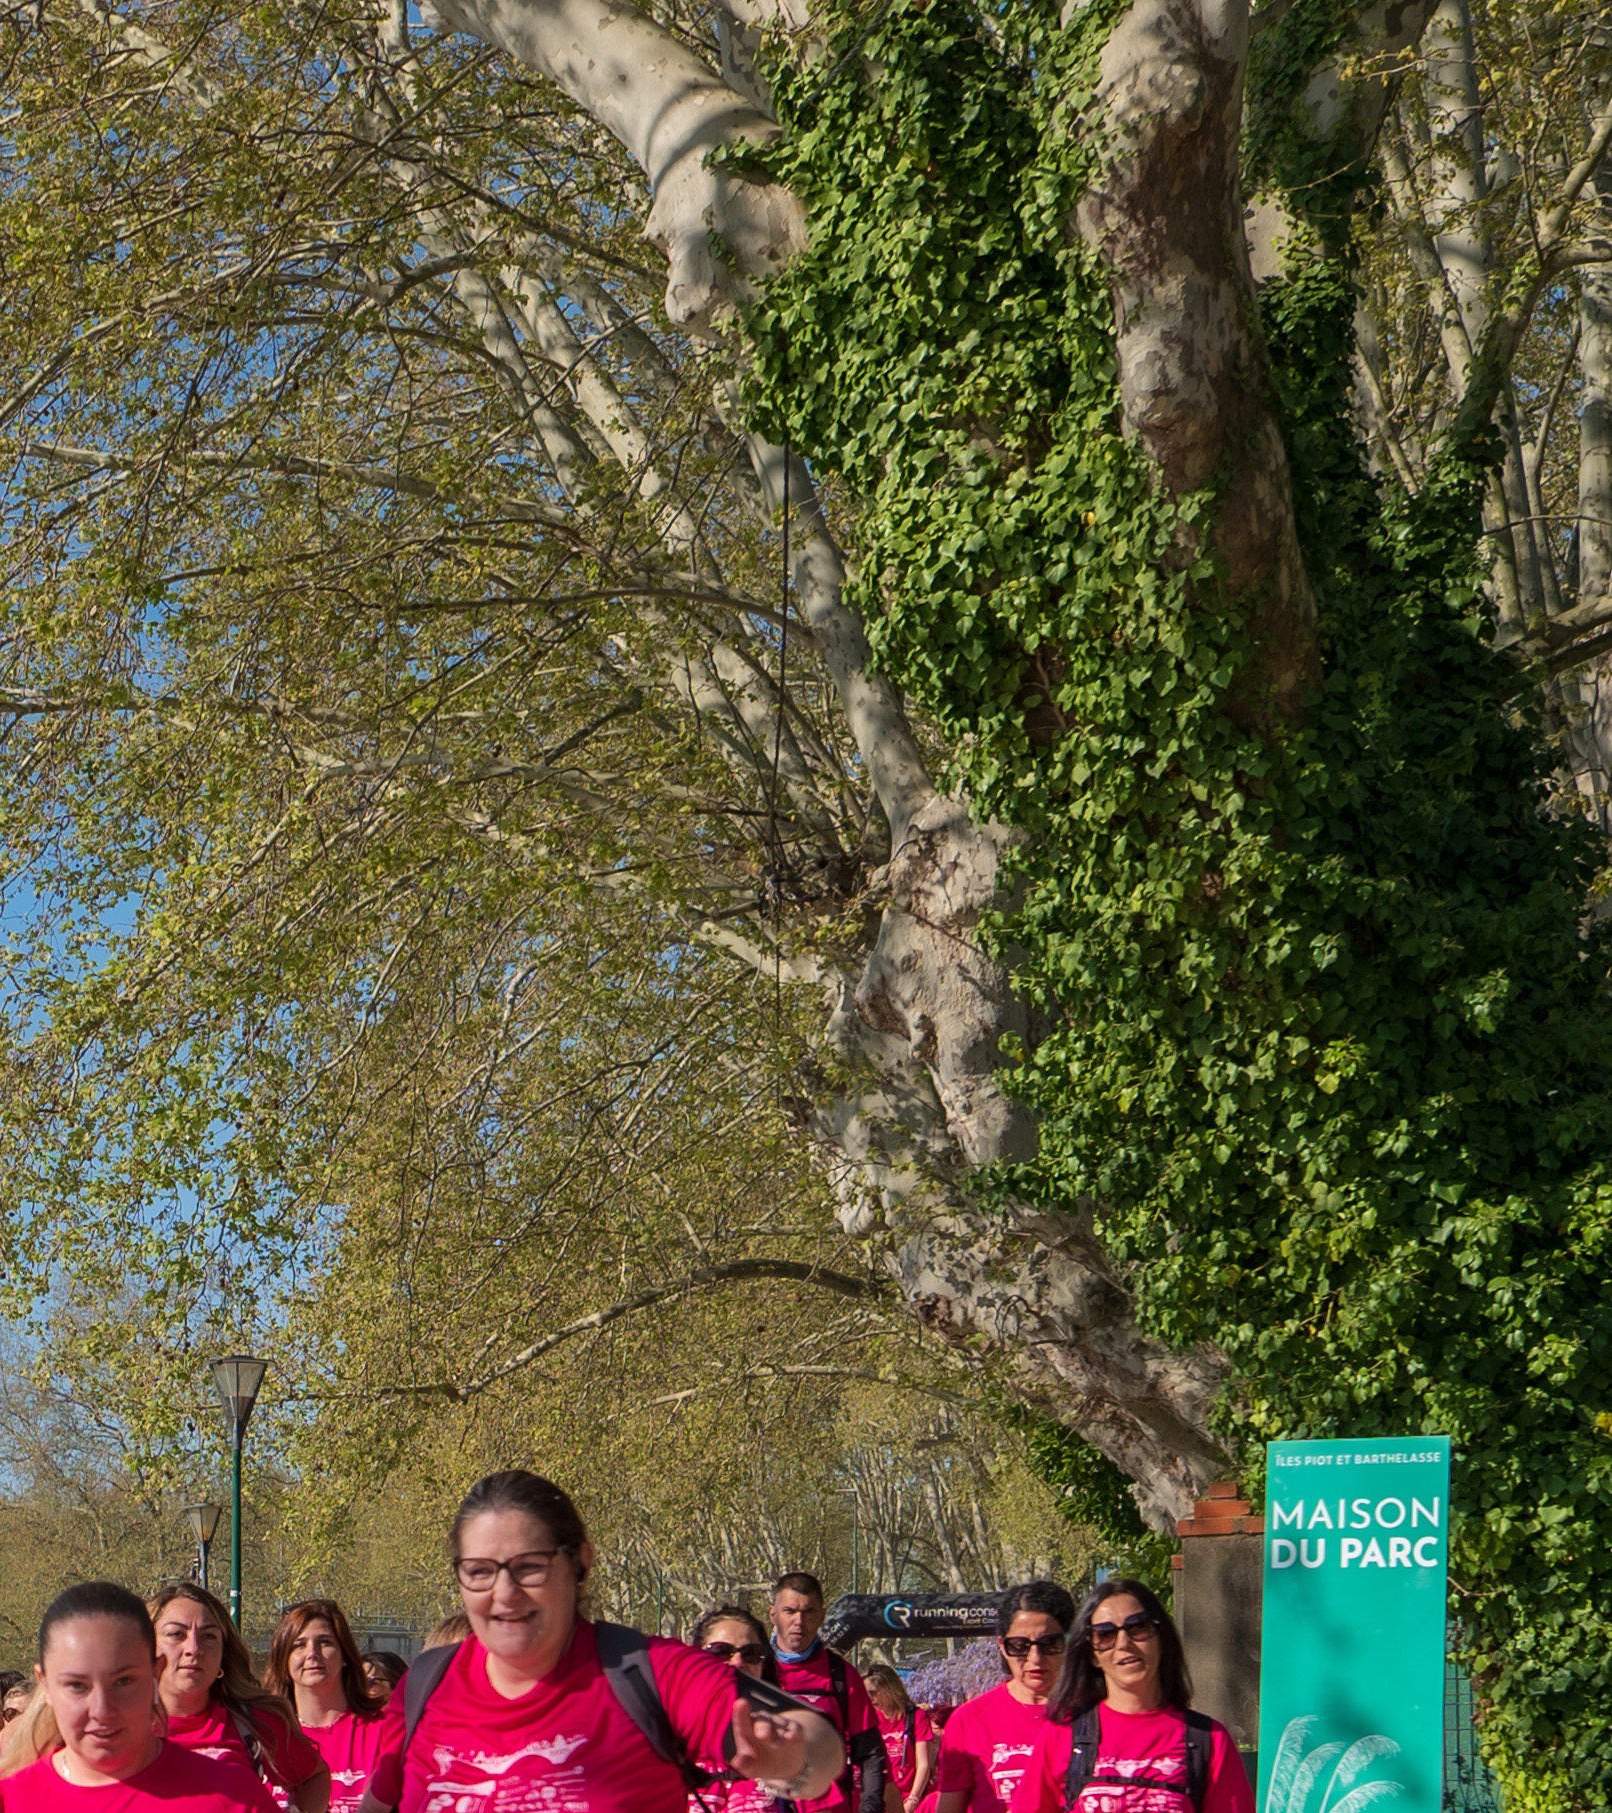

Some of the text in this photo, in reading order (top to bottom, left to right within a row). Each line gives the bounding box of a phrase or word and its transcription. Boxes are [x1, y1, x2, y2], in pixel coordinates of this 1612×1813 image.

[1304, 1455, 1333, 1466] PIOT
[1336, 1454, 1352, 1465] ET
[1354, 1452, 1441, 1465] BARTHELASSE
[1272, 1497, 1440, 1530] MAISON
[1271, 1536, 1439, 1569] DU PARC
